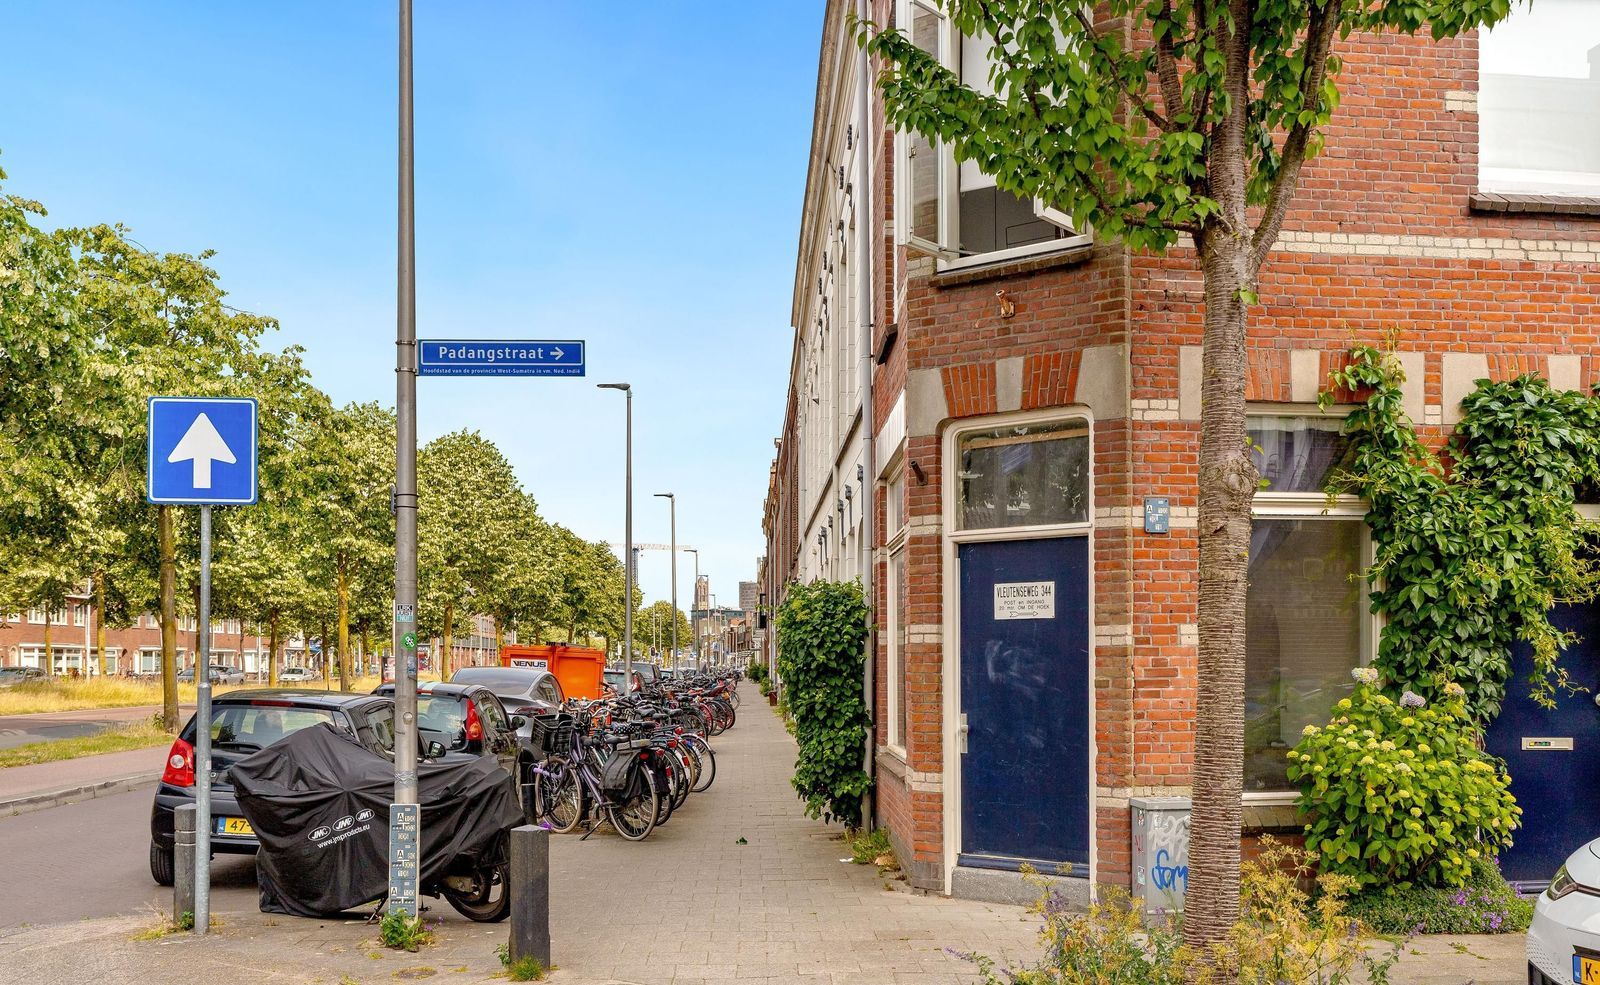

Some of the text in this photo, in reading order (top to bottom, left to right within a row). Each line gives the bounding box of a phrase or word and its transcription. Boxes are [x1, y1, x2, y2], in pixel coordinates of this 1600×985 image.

[439, 346, 544, 362] Padangstraat
[997, 585, 1051, 598] VLEUTENSEWEG 344
[231, 820, 253, 831] 47-
[336, 817, 353, 830] JMP
[312, 827, 328, 839] JMC
[317, 824, 370, 848] www.jmproducts.eu
